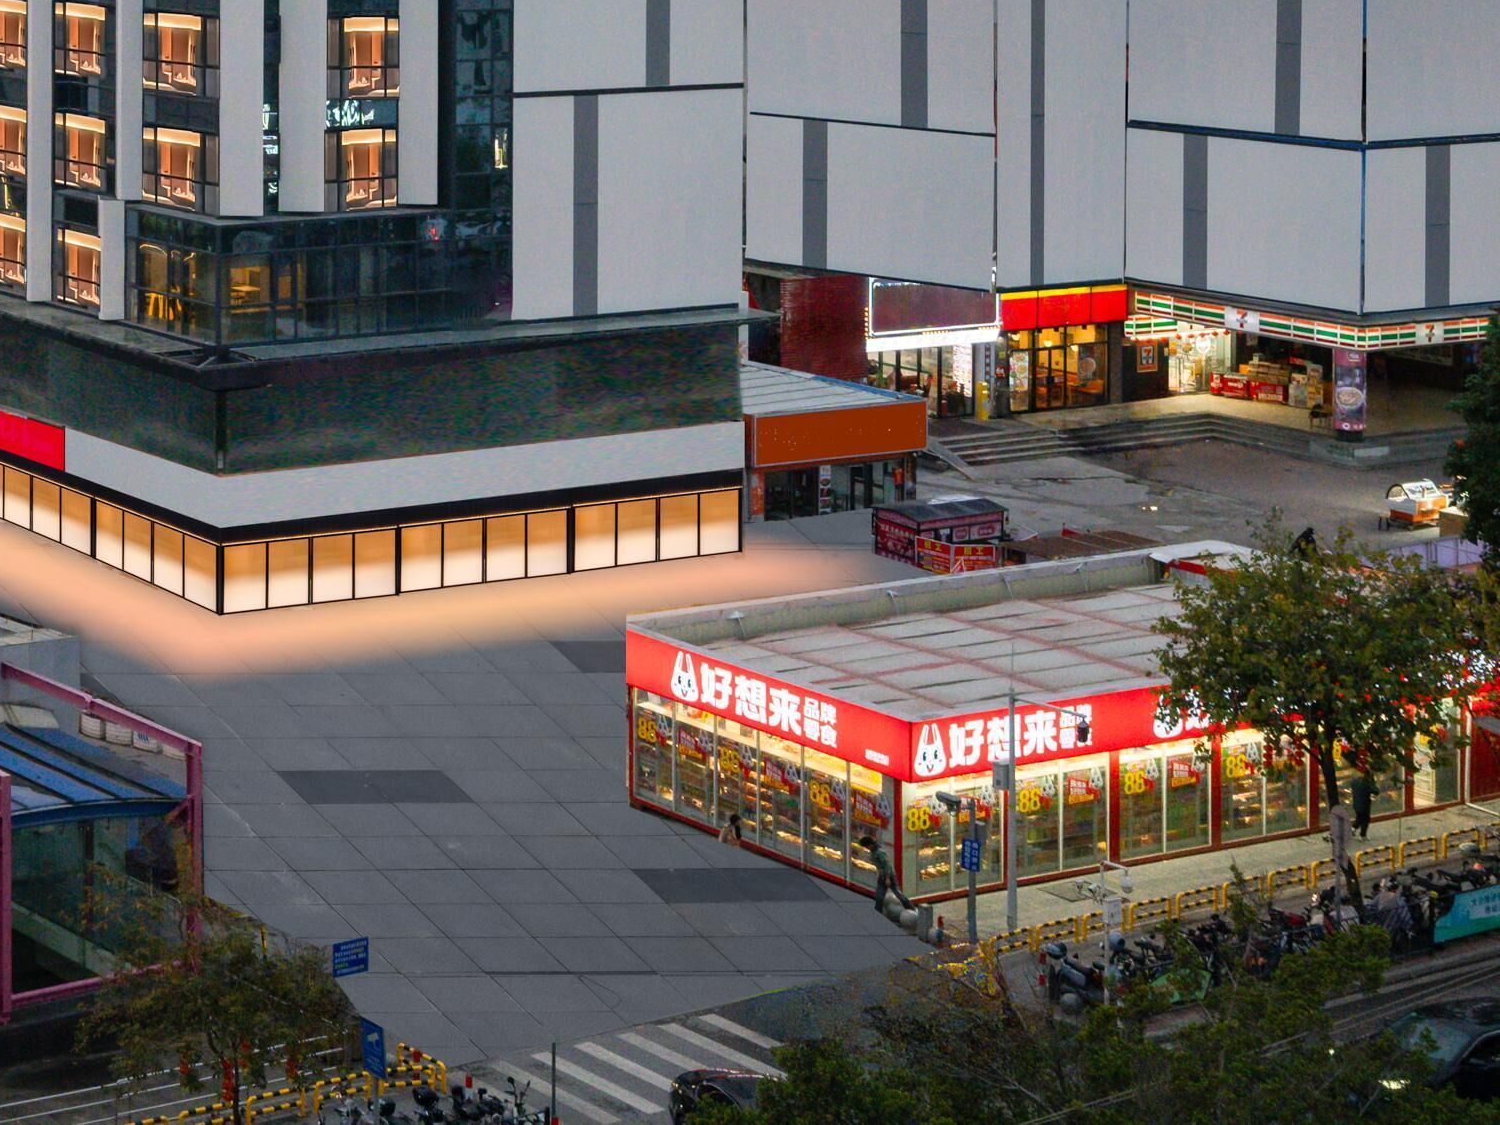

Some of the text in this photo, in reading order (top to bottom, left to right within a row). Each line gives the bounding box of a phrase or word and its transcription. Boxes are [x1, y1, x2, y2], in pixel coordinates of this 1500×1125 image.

[700, 661, 802, 737] 好想来
[803, 696, 837, 725] 品牌
[803, 719, 838, 748] 零食
[949, 709, 1058, 768] 好想来
